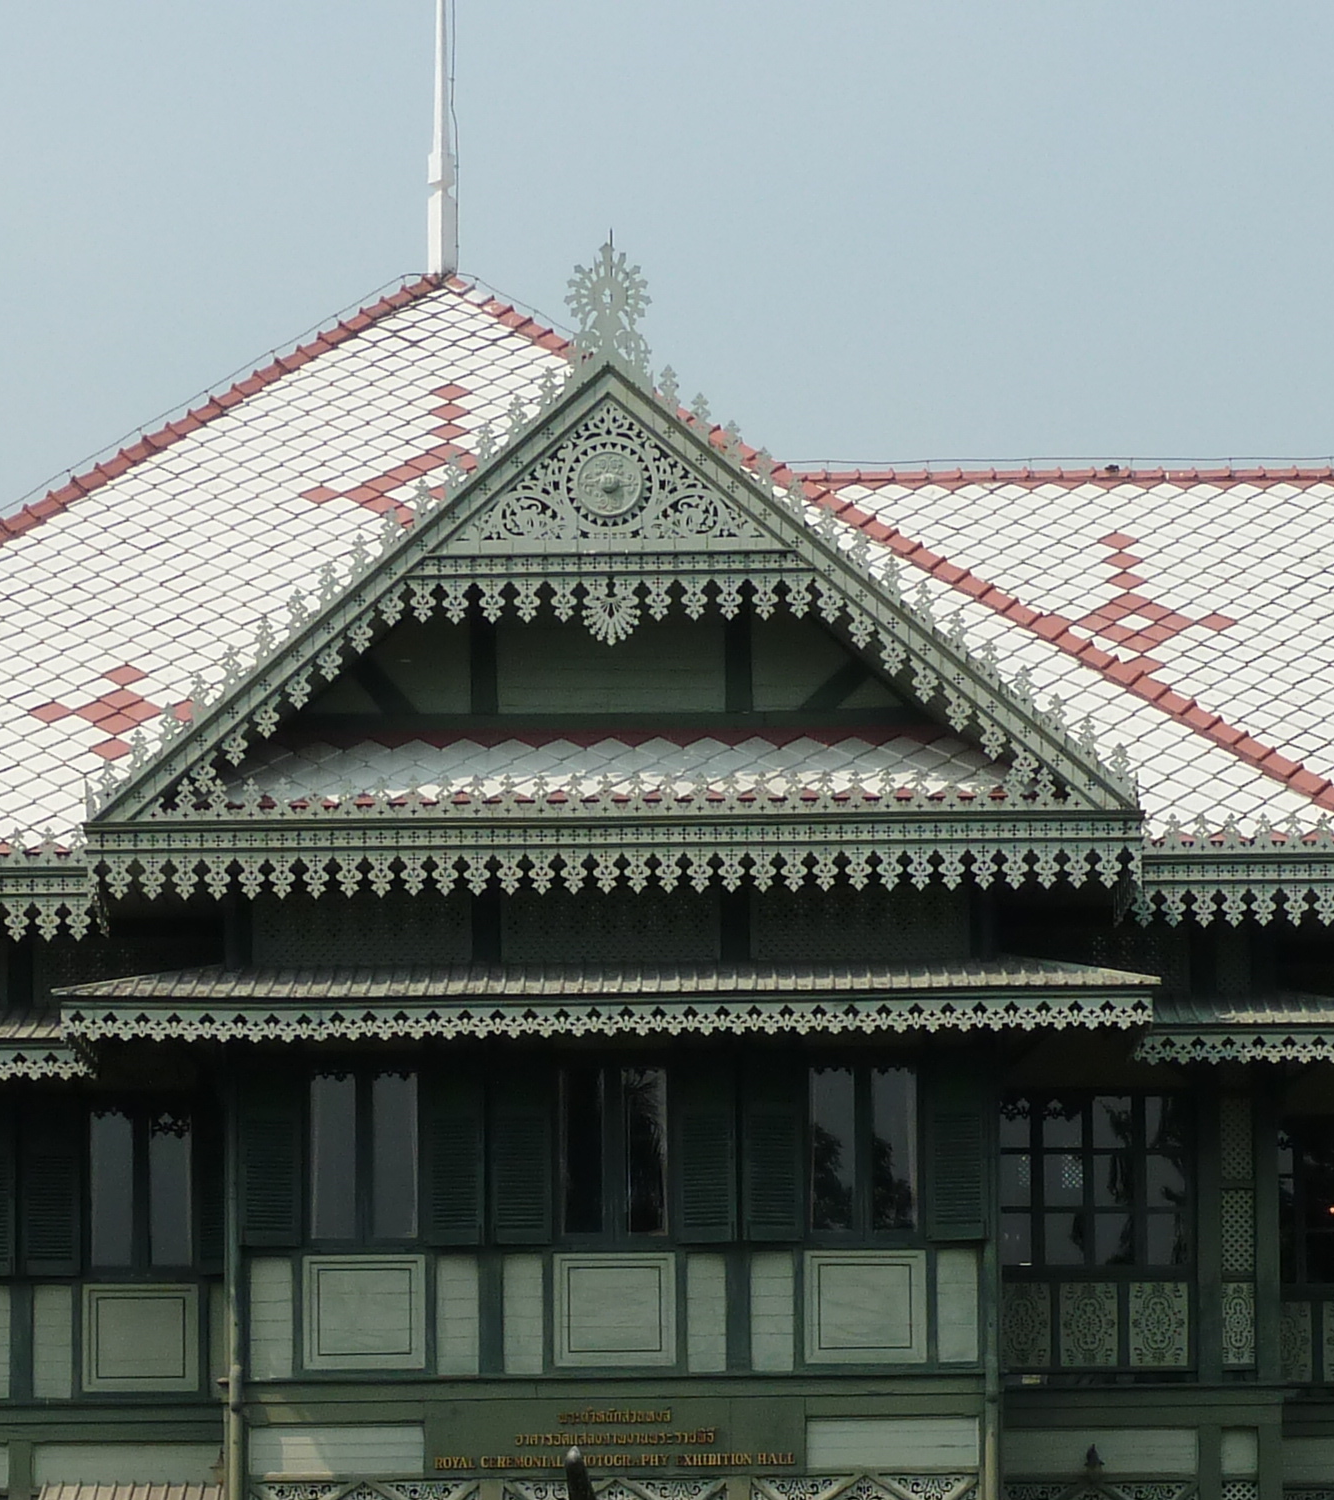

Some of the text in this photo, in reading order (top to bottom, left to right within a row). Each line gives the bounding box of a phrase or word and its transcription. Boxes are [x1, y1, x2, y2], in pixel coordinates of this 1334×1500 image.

[558, 1407, 672, 1424] พระตำหนักสวนหงส์
[435, 1453, 795, 1469] ROYAL CEREMONIAL OTOGRAPHY EXHIBITION HALL
